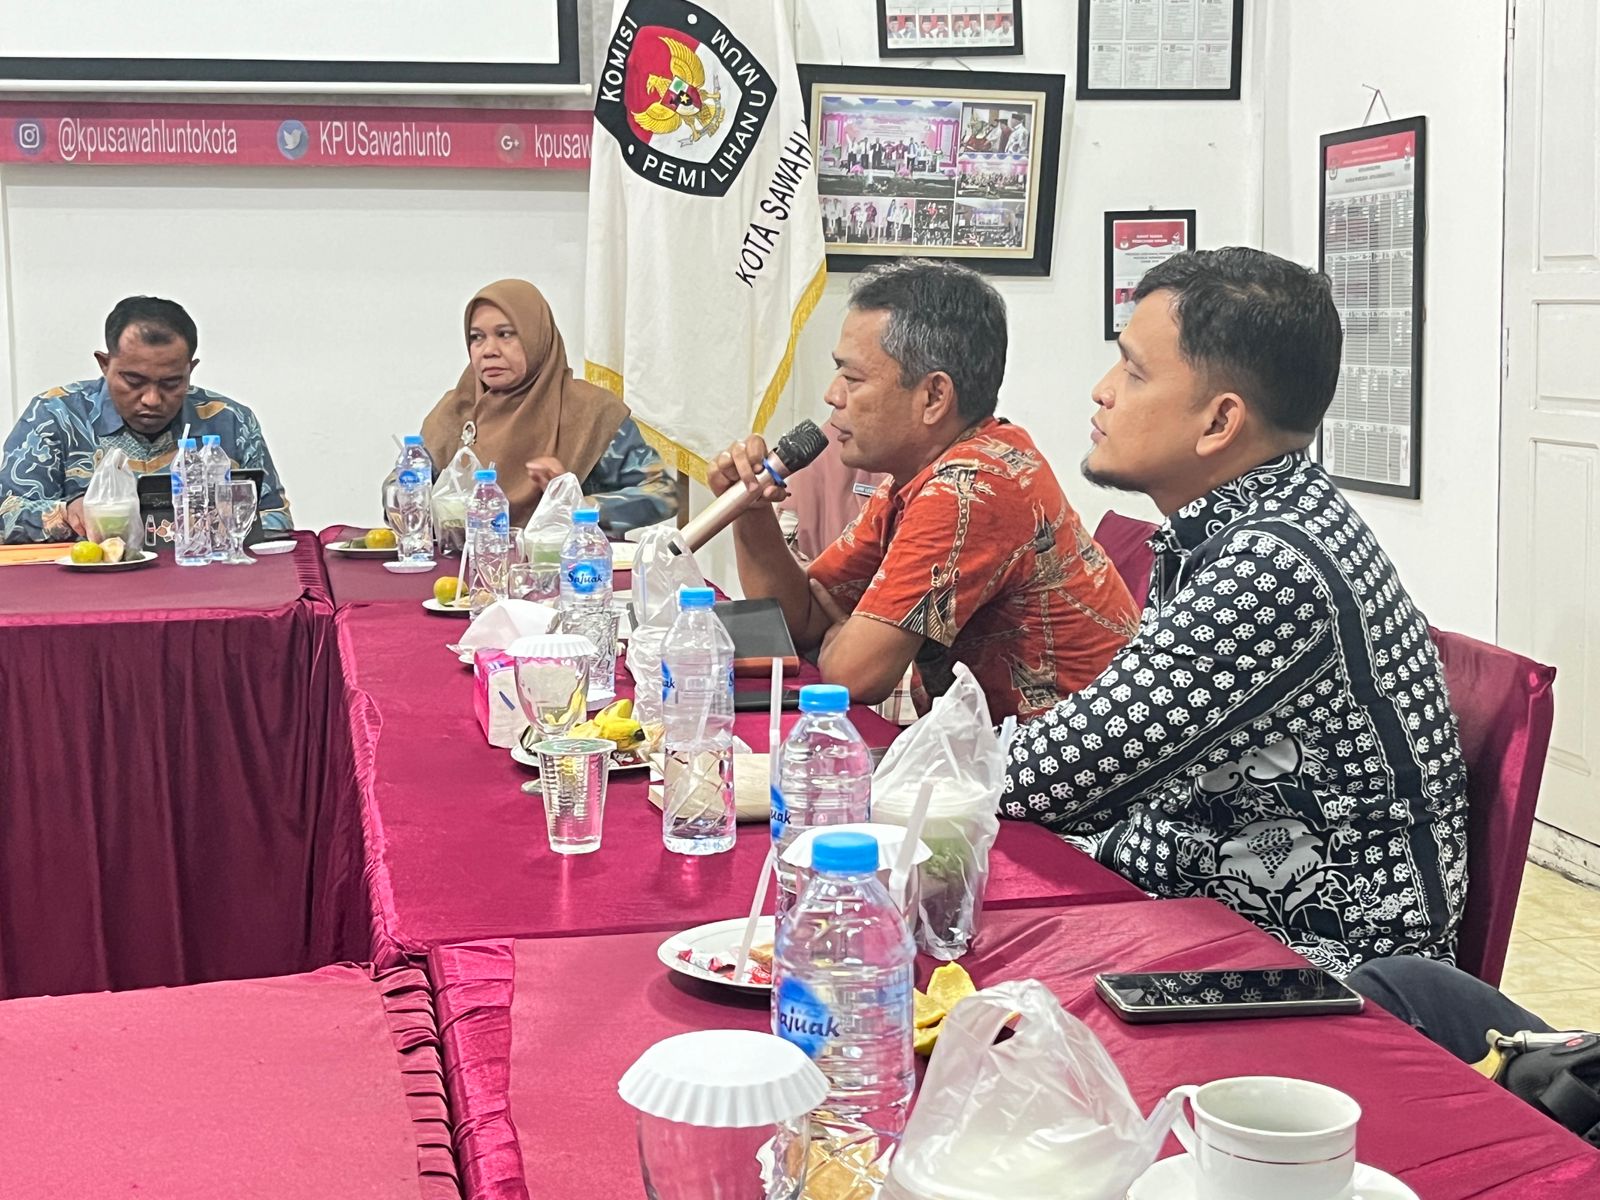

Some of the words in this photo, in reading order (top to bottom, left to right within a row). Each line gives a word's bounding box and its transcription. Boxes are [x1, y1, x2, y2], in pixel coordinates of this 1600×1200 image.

[600, 16, 638, 102] KOMISI
[642, 112, 758, 189] PEMILIHAN
[710, 29, 767, 107] UMUM
[58, 117, 238, 162] @kpusawahluntokota
[319, 121, 452, 158] KPUSawahlunto
[735, 222, 780, 288] KOTA
[778, 1005, 841, 1037] ajuak
